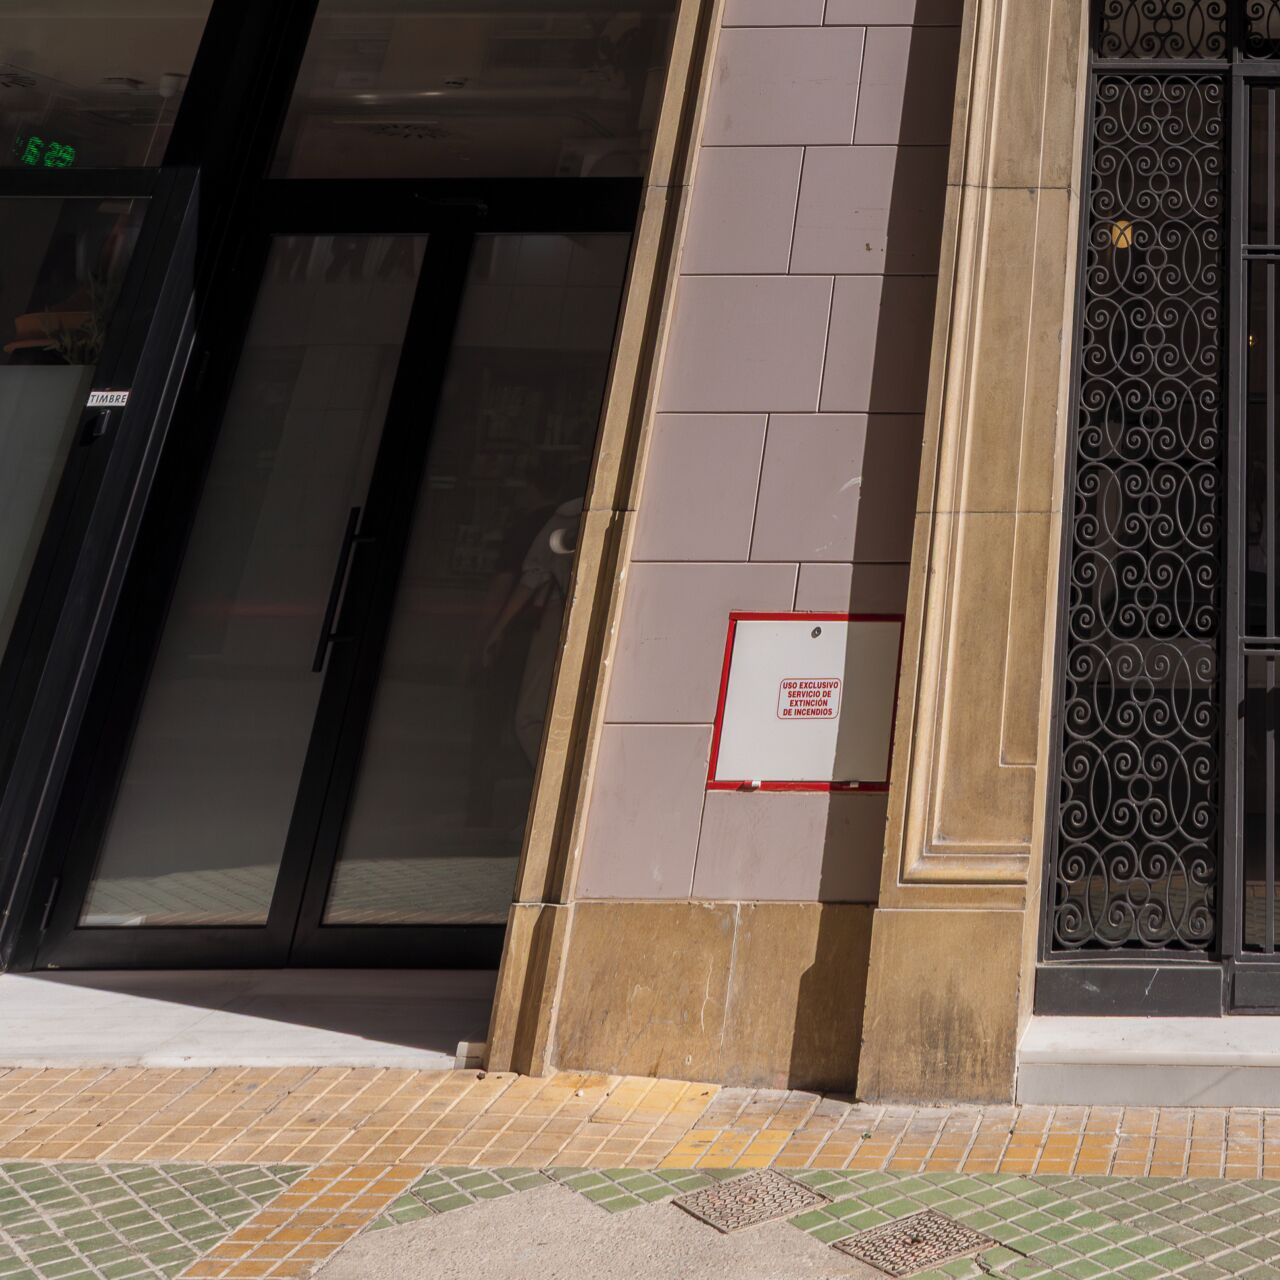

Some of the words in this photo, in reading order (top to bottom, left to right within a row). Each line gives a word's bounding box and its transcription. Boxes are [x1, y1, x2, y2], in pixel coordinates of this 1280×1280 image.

[91, 394, 126, 403] TIMBRE
[799, 681, 839, 689] EXCLUSIVO
[790, 698, 828, 706] EXTINCIÓN
